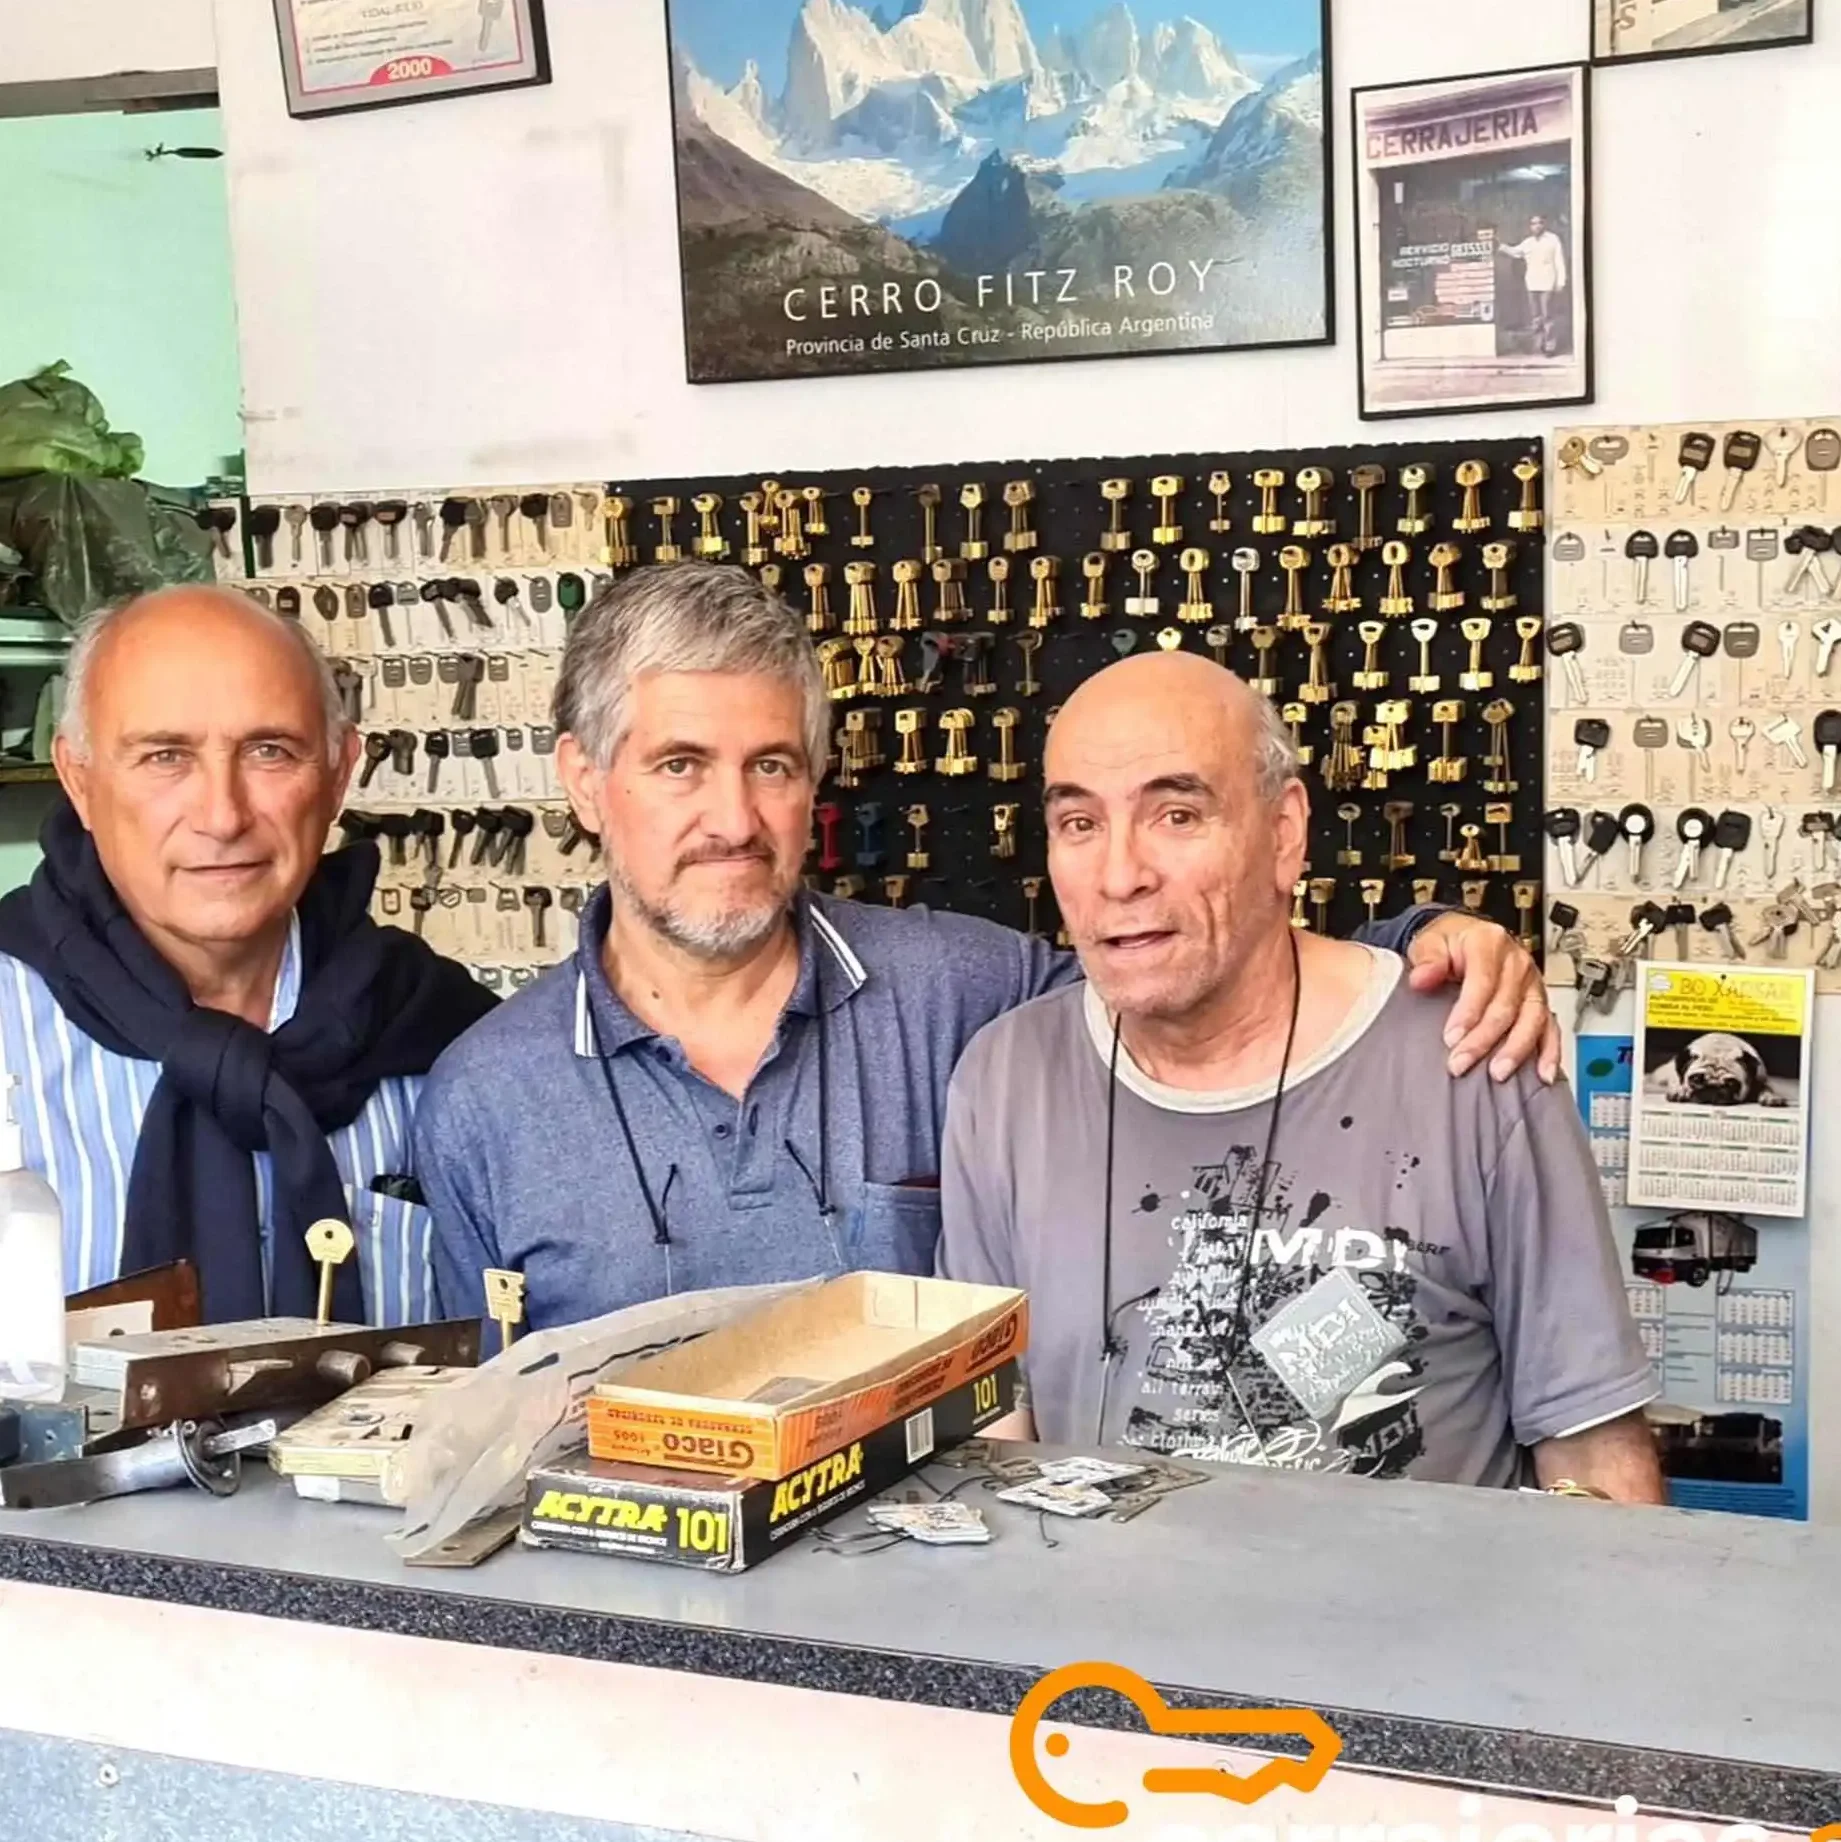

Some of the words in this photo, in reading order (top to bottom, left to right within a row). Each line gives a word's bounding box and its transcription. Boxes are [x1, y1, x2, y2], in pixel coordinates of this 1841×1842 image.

[387, 58, 432, 80] 2000
[1366, 107, 1538, 160] CERRAJERIA
[783, 279, 942, 321] CERRO
[977, 269, 1078, 307] FITZ
[1114, 259, 1214, 299] ROY
[786, 336, 864, 356] Provincia
[871, 333, 893, 351] de
[900, 329, 951, 349] Santa
[957, 326, 1000, 345] Cruz
[1021, 317, 1112, 344] República
[1119, 312, 1215, 337] Argentina
[1171, 1211, 1247, 1231] california
[973, 1374, 999, 1414] 101
[663, 1432, 755, 1470] Giaco
[769, 1441, 865, 1524] ACYTRA
[532, 1490, 668, 1533] ACYTRA
[676, 1507, 729, 1554] 101
